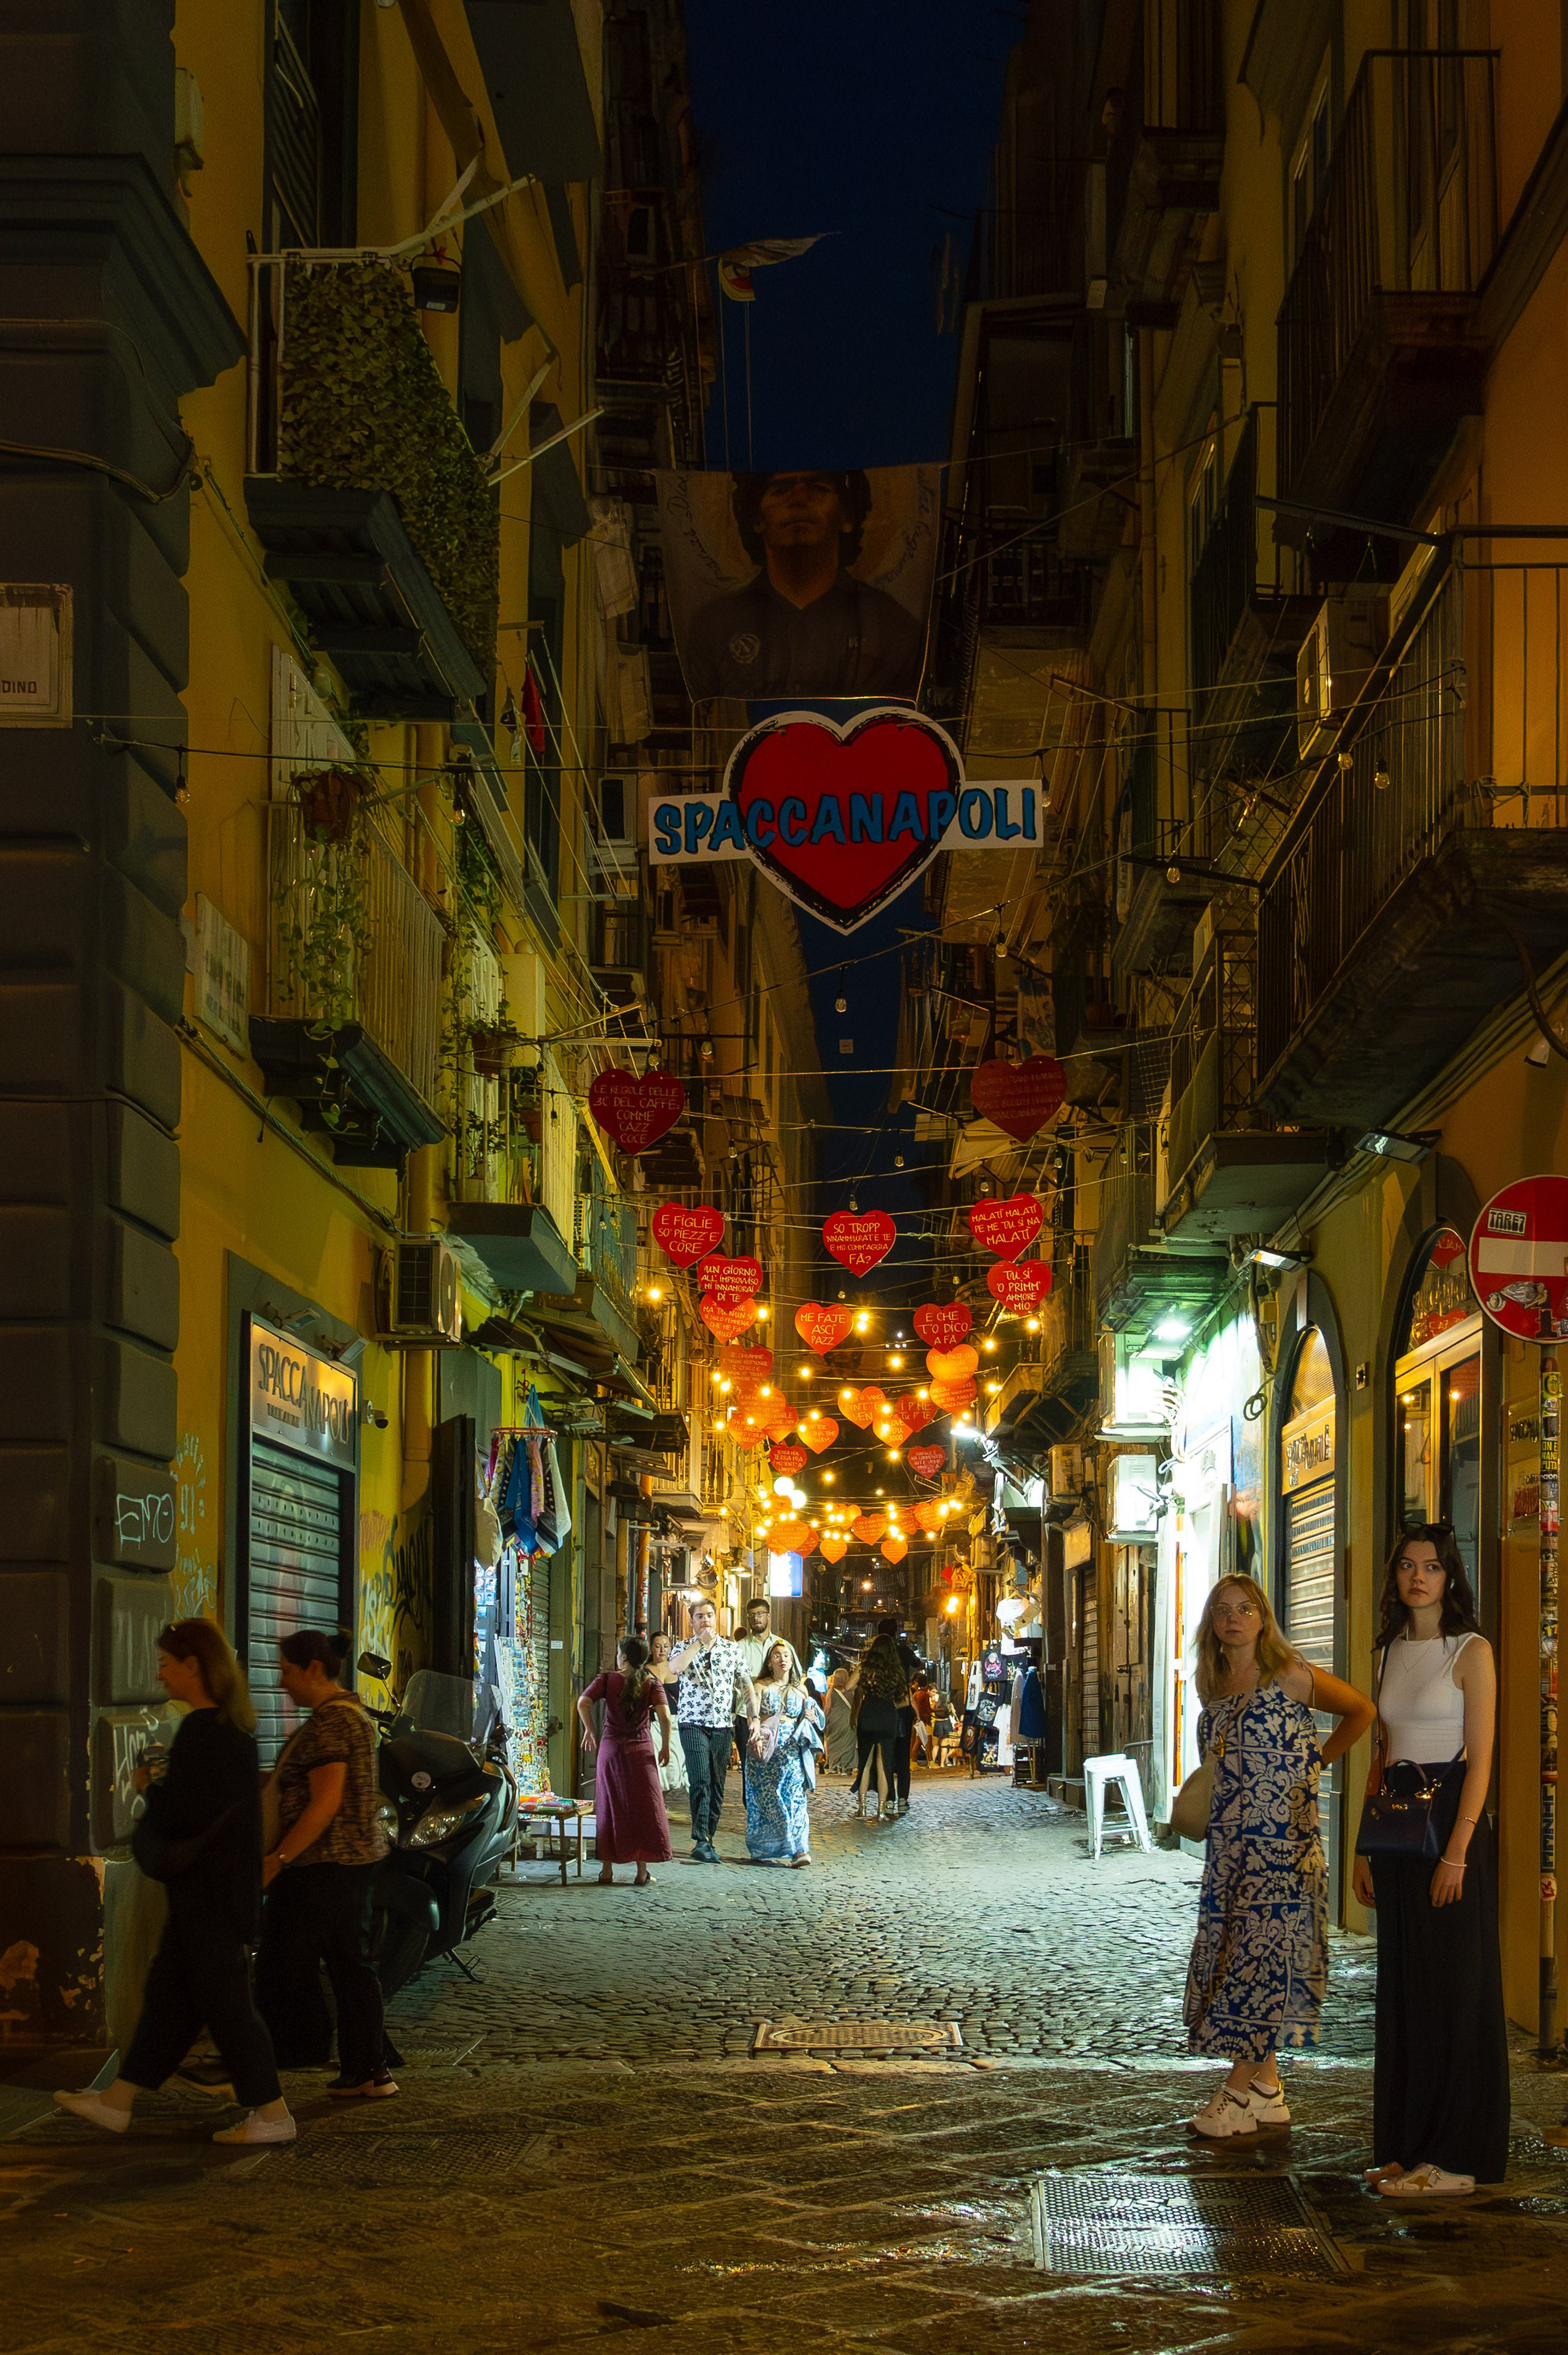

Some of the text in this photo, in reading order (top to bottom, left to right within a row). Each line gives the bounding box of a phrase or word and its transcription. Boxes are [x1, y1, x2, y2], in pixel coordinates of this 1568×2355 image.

[654, 787, 1037, 855] SPACCANAPOLI
[594, 1084, 679, 1097] LE REGOLE DELLE
[614, 1097, 636, 1108] DEL
[616, 1109, 655, 1122] COMME
[619, 1122, 650, 1132] CAZZ
[620, 1133, 648, 1144] COCE
[662, 1214, 670, 1225] E
[974, 1224, 985, 1233] PE
[987, 1222, 999, 1232] ME
[1001, 1220, 1016, 1229] TU
[1027, 1216, 1041, 1226] NA
[834, 1222, 881, 1234] SO TROPP
[704, 1264, 756, 1276] UN GIORNO
[1003, 1270, 1020, 1280] TU
[720, 1274, 758, 1285] IMPROVVISO
[715, 1282, 754, 1293] INNAMORAI
[717, 1291, 741, 1302] DI TE
[1006, 1292, 1036, 1302] AMMORE
[1014, 1301, 1030, 1311] MIO
[801, 1313, 846, 1323] ME FAJE
[925, 1310, 959, 1322] E CHE
[944, 1321, 968, 1333] DICO
[811, 1335, 834, 1345] PAZZ
[934, 1336, 941, 1345] A
